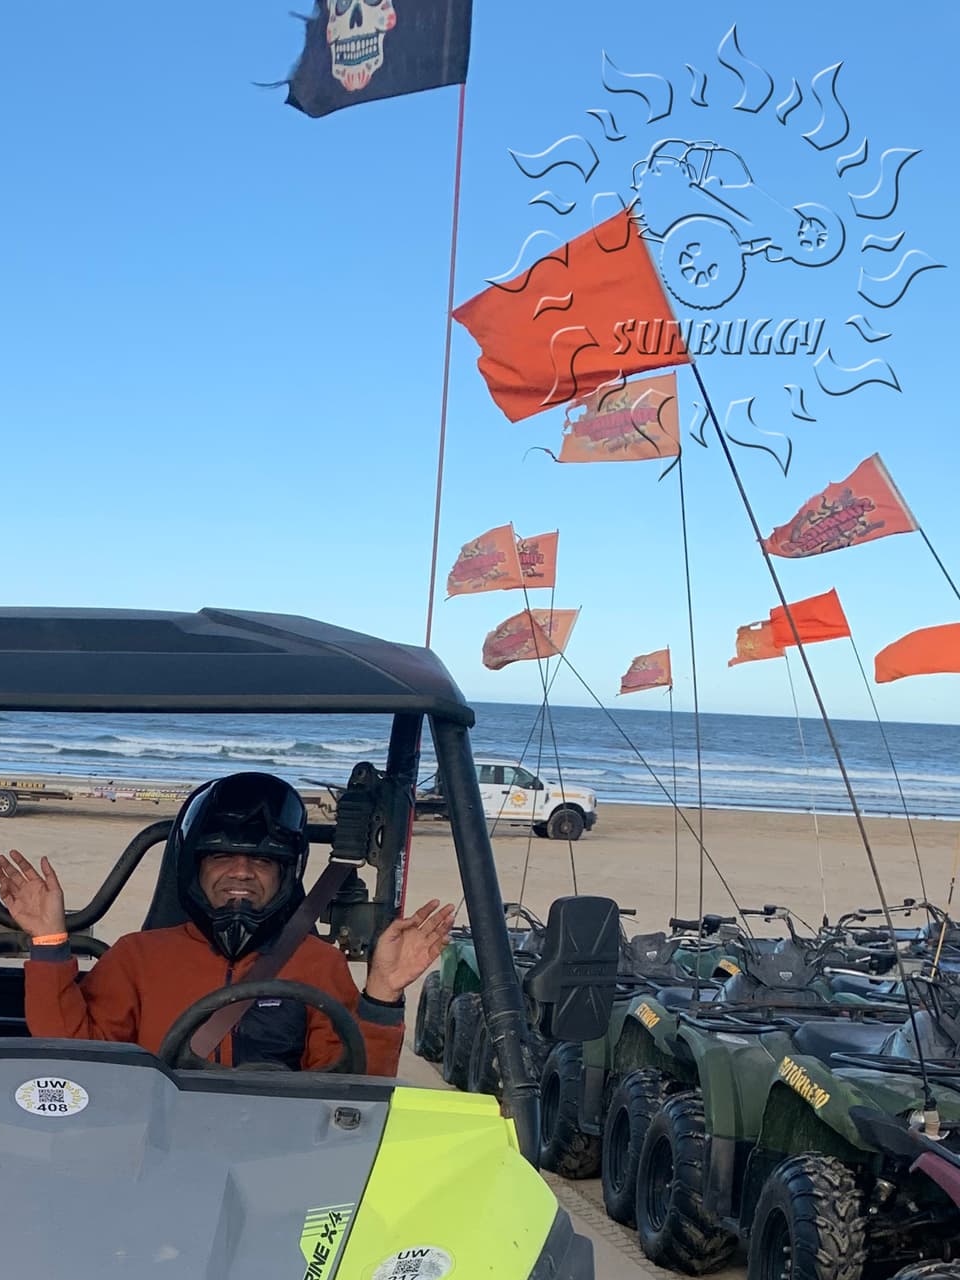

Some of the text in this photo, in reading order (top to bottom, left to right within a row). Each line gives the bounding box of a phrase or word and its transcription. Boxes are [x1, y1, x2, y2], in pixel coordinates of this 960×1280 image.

[37, 1080, 67, 1089] UW
[37, 1103, 68, 1112] 408
[320, 1211, 342, 1244] X4
[397, 1249, 430, 1260] UW
